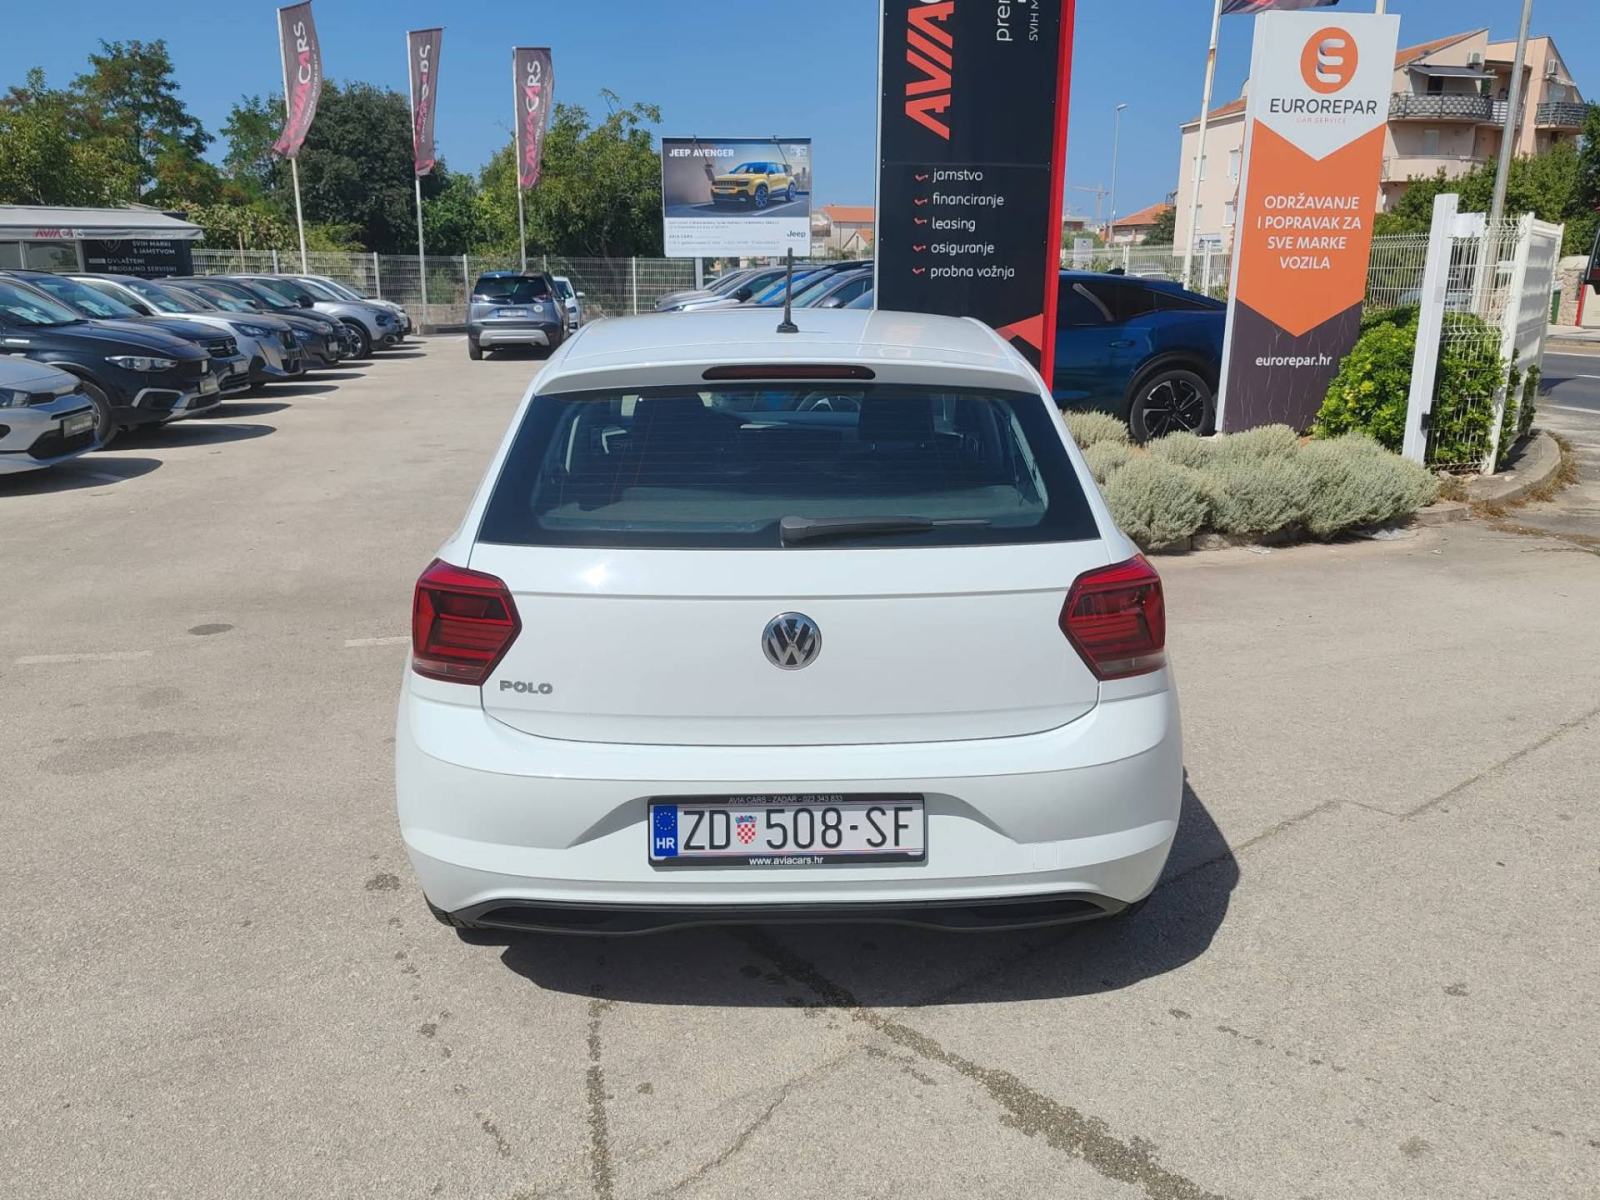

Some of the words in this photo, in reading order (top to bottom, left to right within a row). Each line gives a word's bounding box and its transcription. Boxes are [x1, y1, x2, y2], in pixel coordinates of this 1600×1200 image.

[1029, 13, 1039, 41] SVIH
[905, 0, 955, 140] AVIA
[1269, 98, 1378, 115] EUROREPAR
[669, 149, 691, 158] JEEP
[693, 149, 735, 158] AVENGER
[932, 168, 983, 183] jamstvo
[932, 192, 1005, 208] financiranje
[1264, 193, 1361, 210] ODRŽAVANJE
[931, 216, 976, 232] leasing
[1257, 216, 1262, 229] I
[1264, 216, 1340, 230] POPRAVAK
[1343, 216, 1361, 230] ZA
[786, 229, 806, 239] Jeep
[931, 242, 995, 256] osiguranje
[1267, 236, 1294, 249] SVE
[1296, 236, 1347, 250] MARKE
[1279, 256, 1330, 270] VOZILA
[930, 265, 974, 279] probna
[976, 265, 1015, 280] vožnja
[1255, 352, 1333, 368] eurorepar.hr
[499, 680, 553, 695] POLO
[683, 809, 731, 850] ZD
[766, 806, 914, 850] 508-SF
[655, 837, 675, 849] HR
[749, 856, 824, 866] www.aviacars.hr
